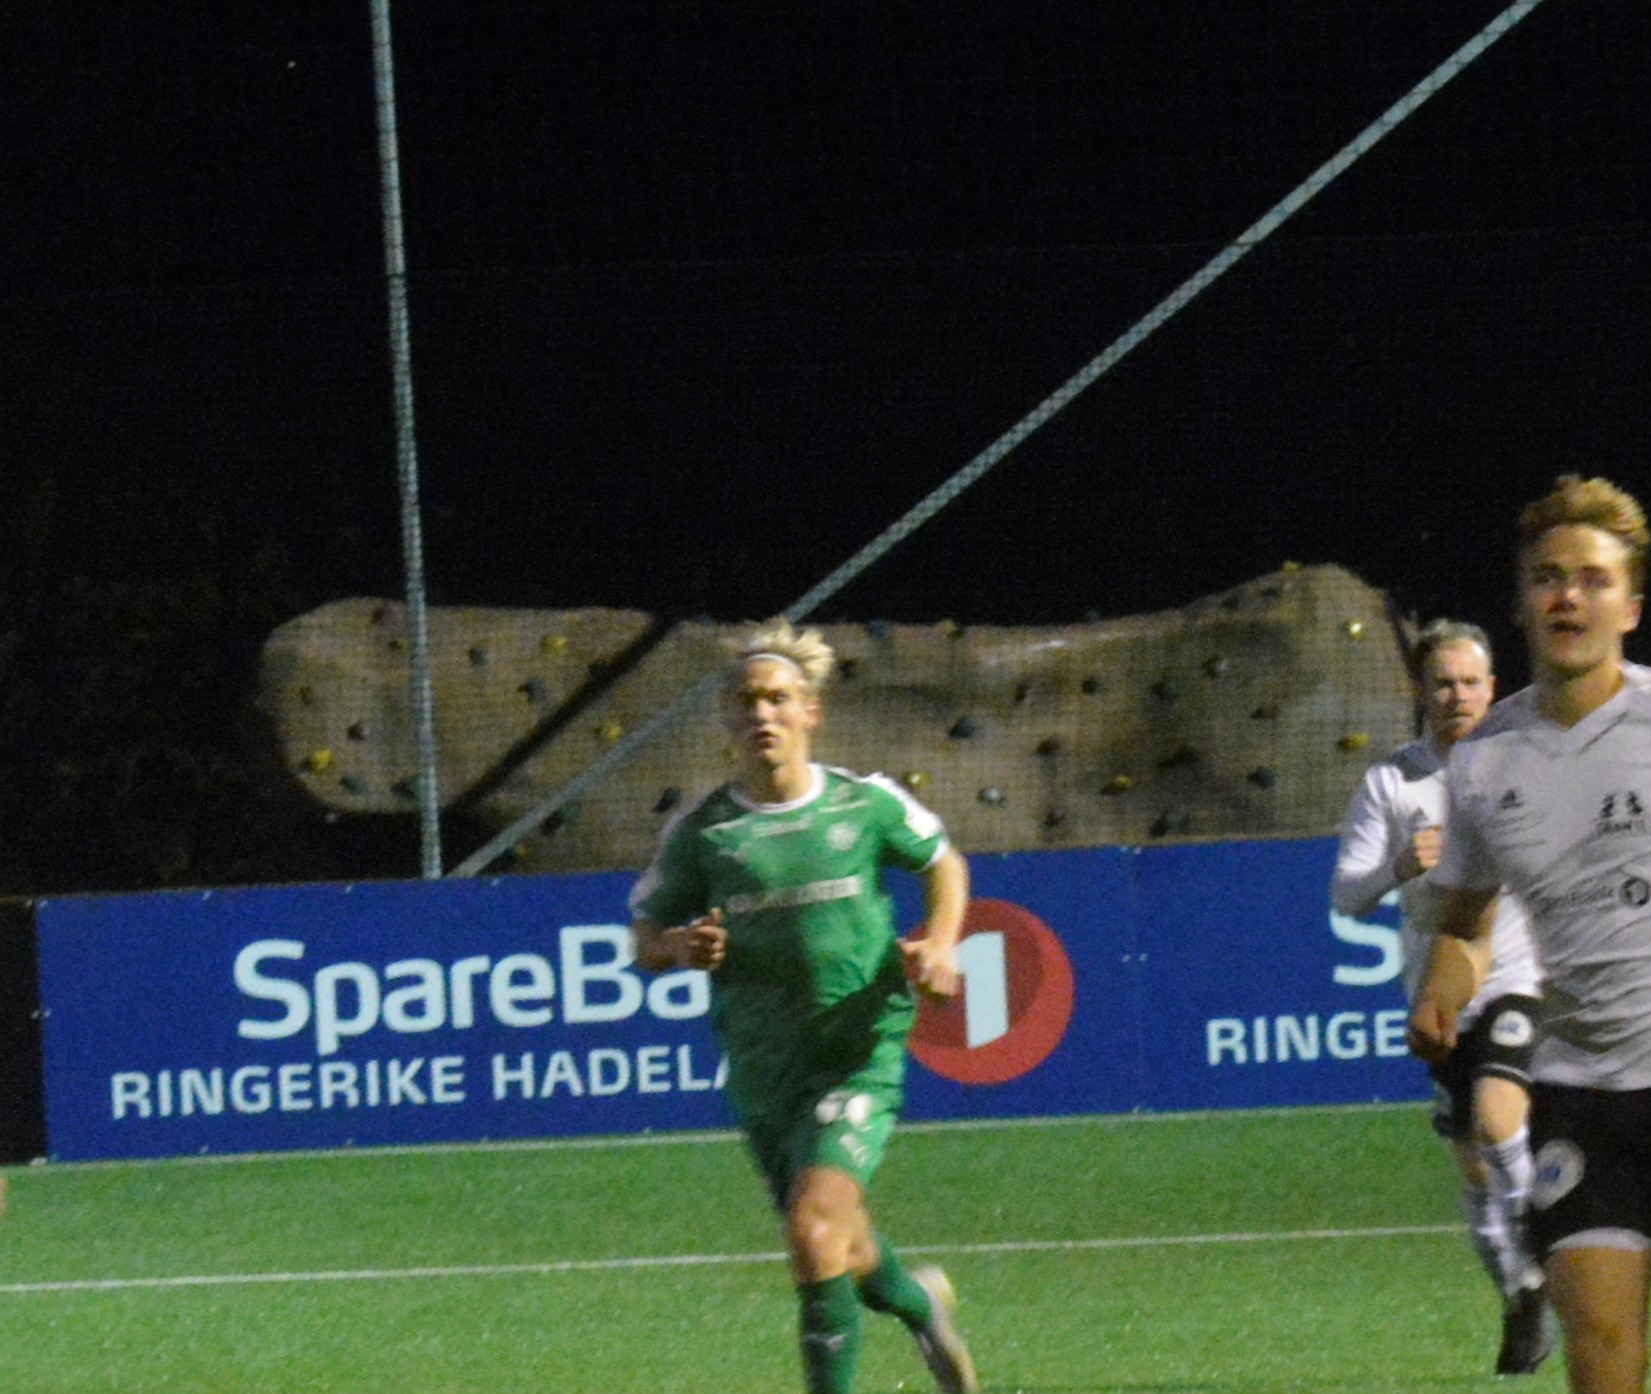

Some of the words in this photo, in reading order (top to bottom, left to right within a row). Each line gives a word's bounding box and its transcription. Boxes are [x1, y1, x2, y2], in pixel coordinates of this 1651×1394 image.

[233, 923, 711, 1056] SpareBa
[955, 931, 1009, 1050] 1
[111, 1056, 466, 1120] RINGERIKE
[491, 1044, 729, 1101] HADEL
[1206, 1010, 1410, 1067] RINGE
